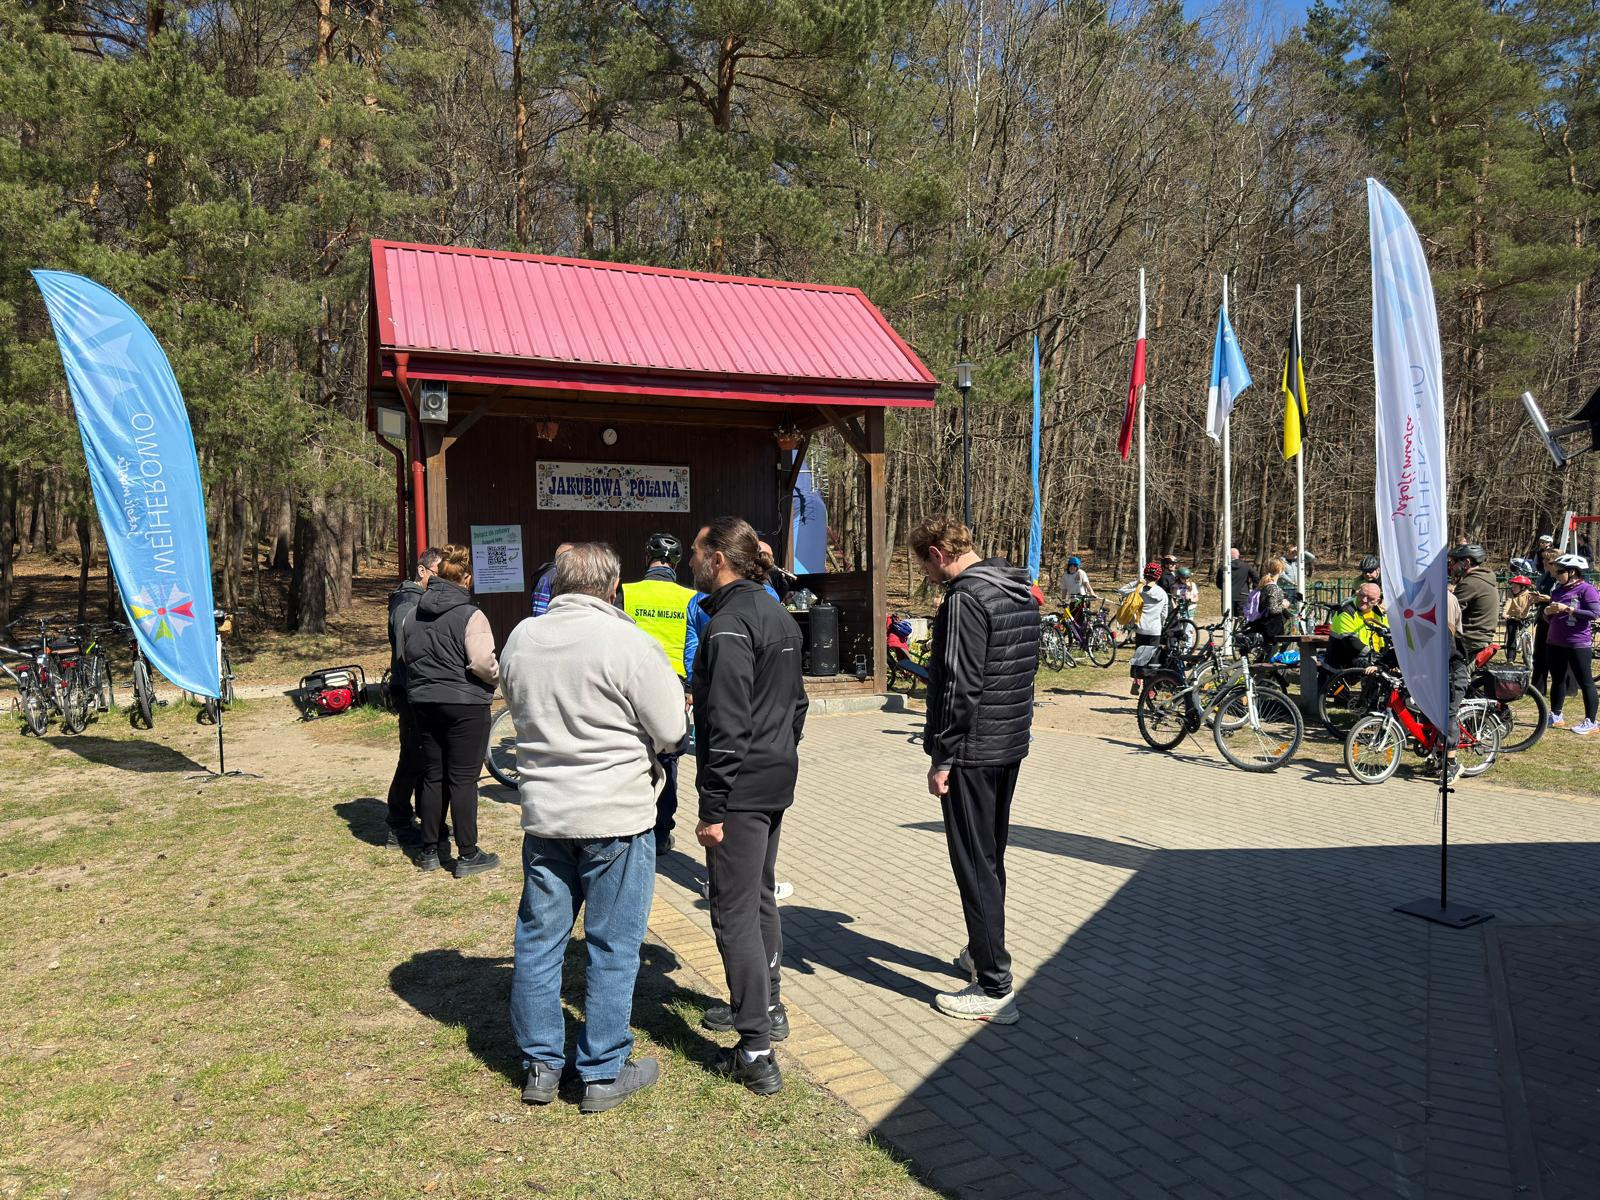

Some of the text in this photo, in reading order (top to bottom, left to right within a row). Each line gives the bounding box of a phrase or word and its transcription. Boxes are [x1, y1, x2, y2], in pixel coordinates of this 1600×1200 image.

[548, 476, 622, 497] JAKUBOWA
[635, 608, 685, 620] STRAŻ MIEJSKA
